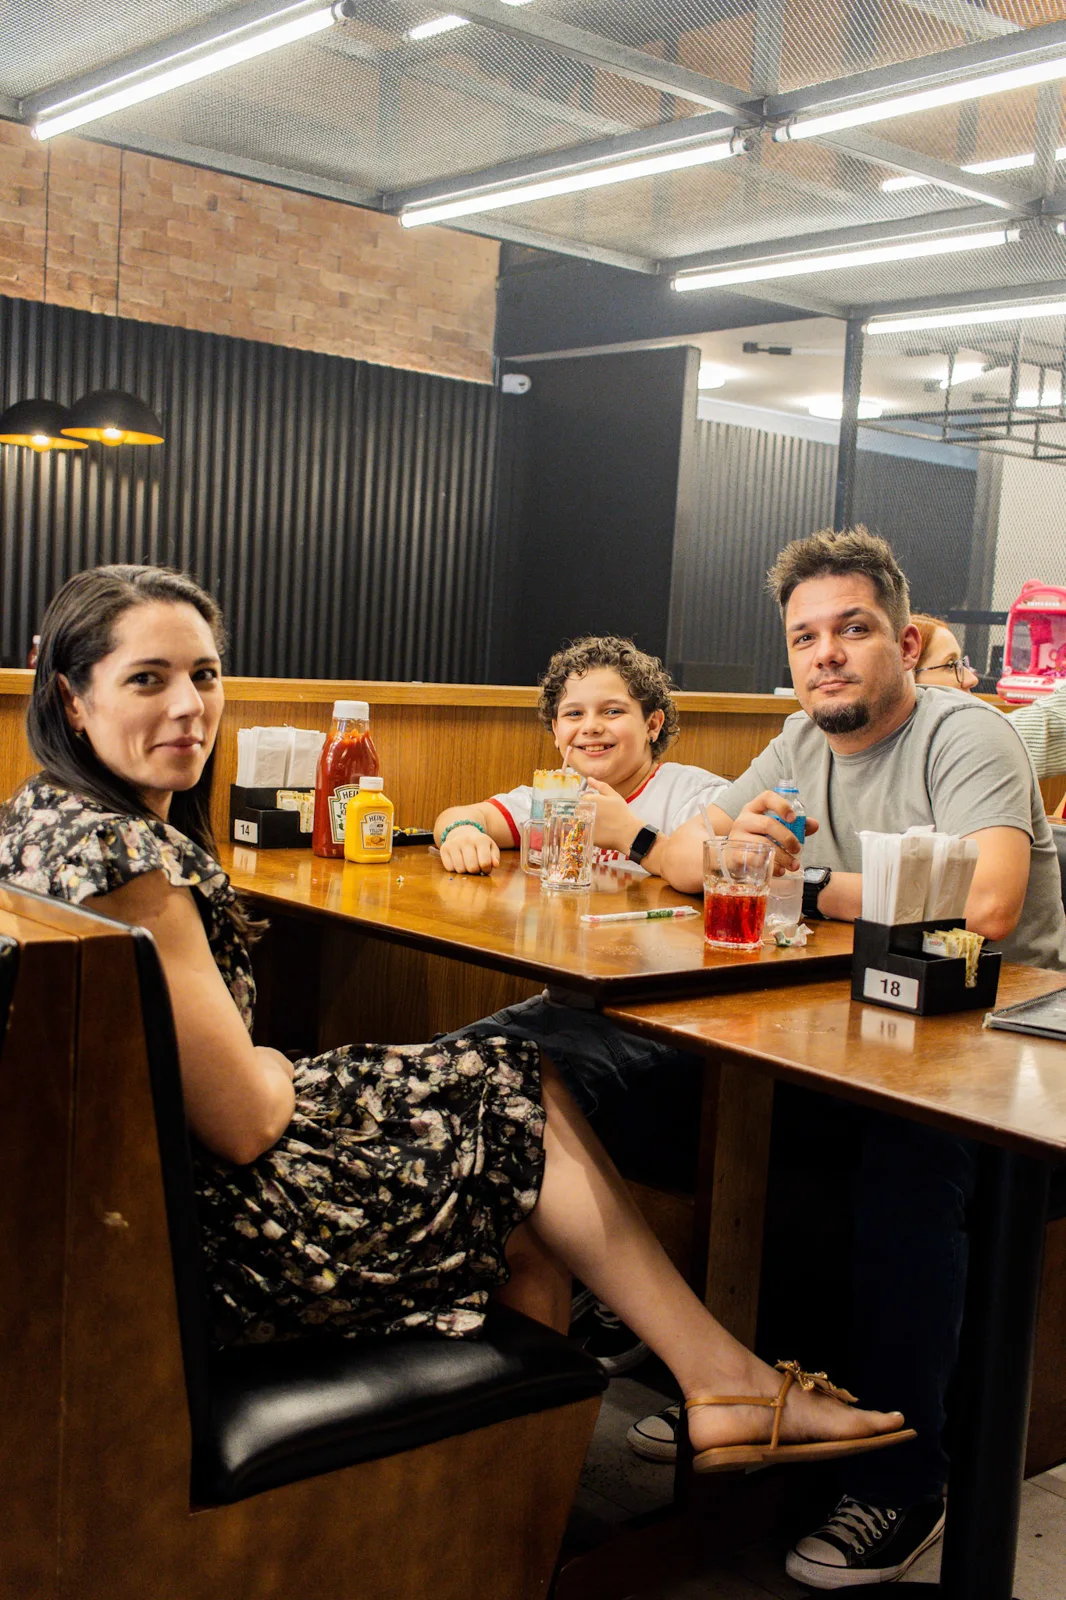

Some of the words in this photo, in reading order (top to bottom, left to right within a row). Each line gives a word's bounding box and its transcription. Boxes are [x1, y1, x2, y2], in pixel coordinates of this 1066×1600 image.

[342, 790, 359, 799] HEI
[368, 814, 386, 822] HEINZ
[240, 824, 250, 836] 14
[880, 978, 900, 997] 18
